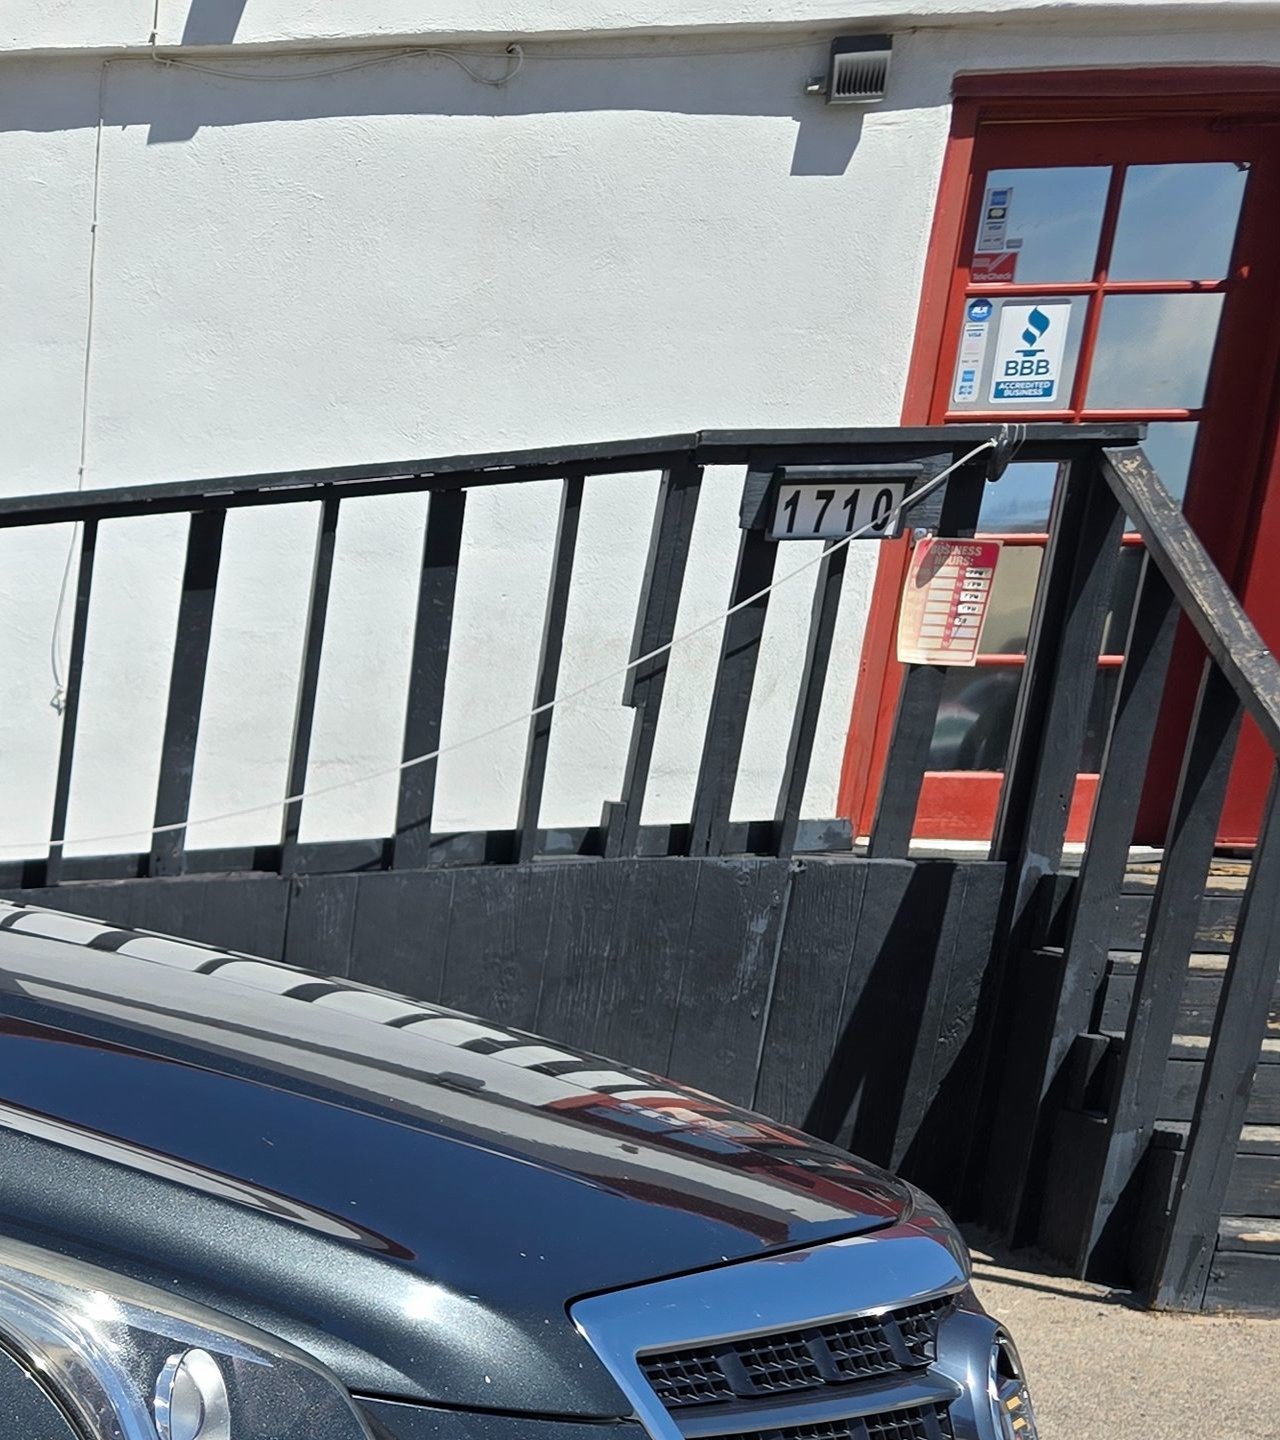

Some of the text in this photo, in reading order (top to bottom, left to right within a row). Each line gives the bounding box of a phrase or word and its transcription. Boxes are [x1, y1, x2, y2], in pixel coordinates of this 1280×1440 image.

[1003, 359, 1051, 377] BBB
[998, 380, 1051, 390] ACCREDITED
[1003, 388, 1044, 397] BUSINESS
[783, 487, 894, 534] 1710
